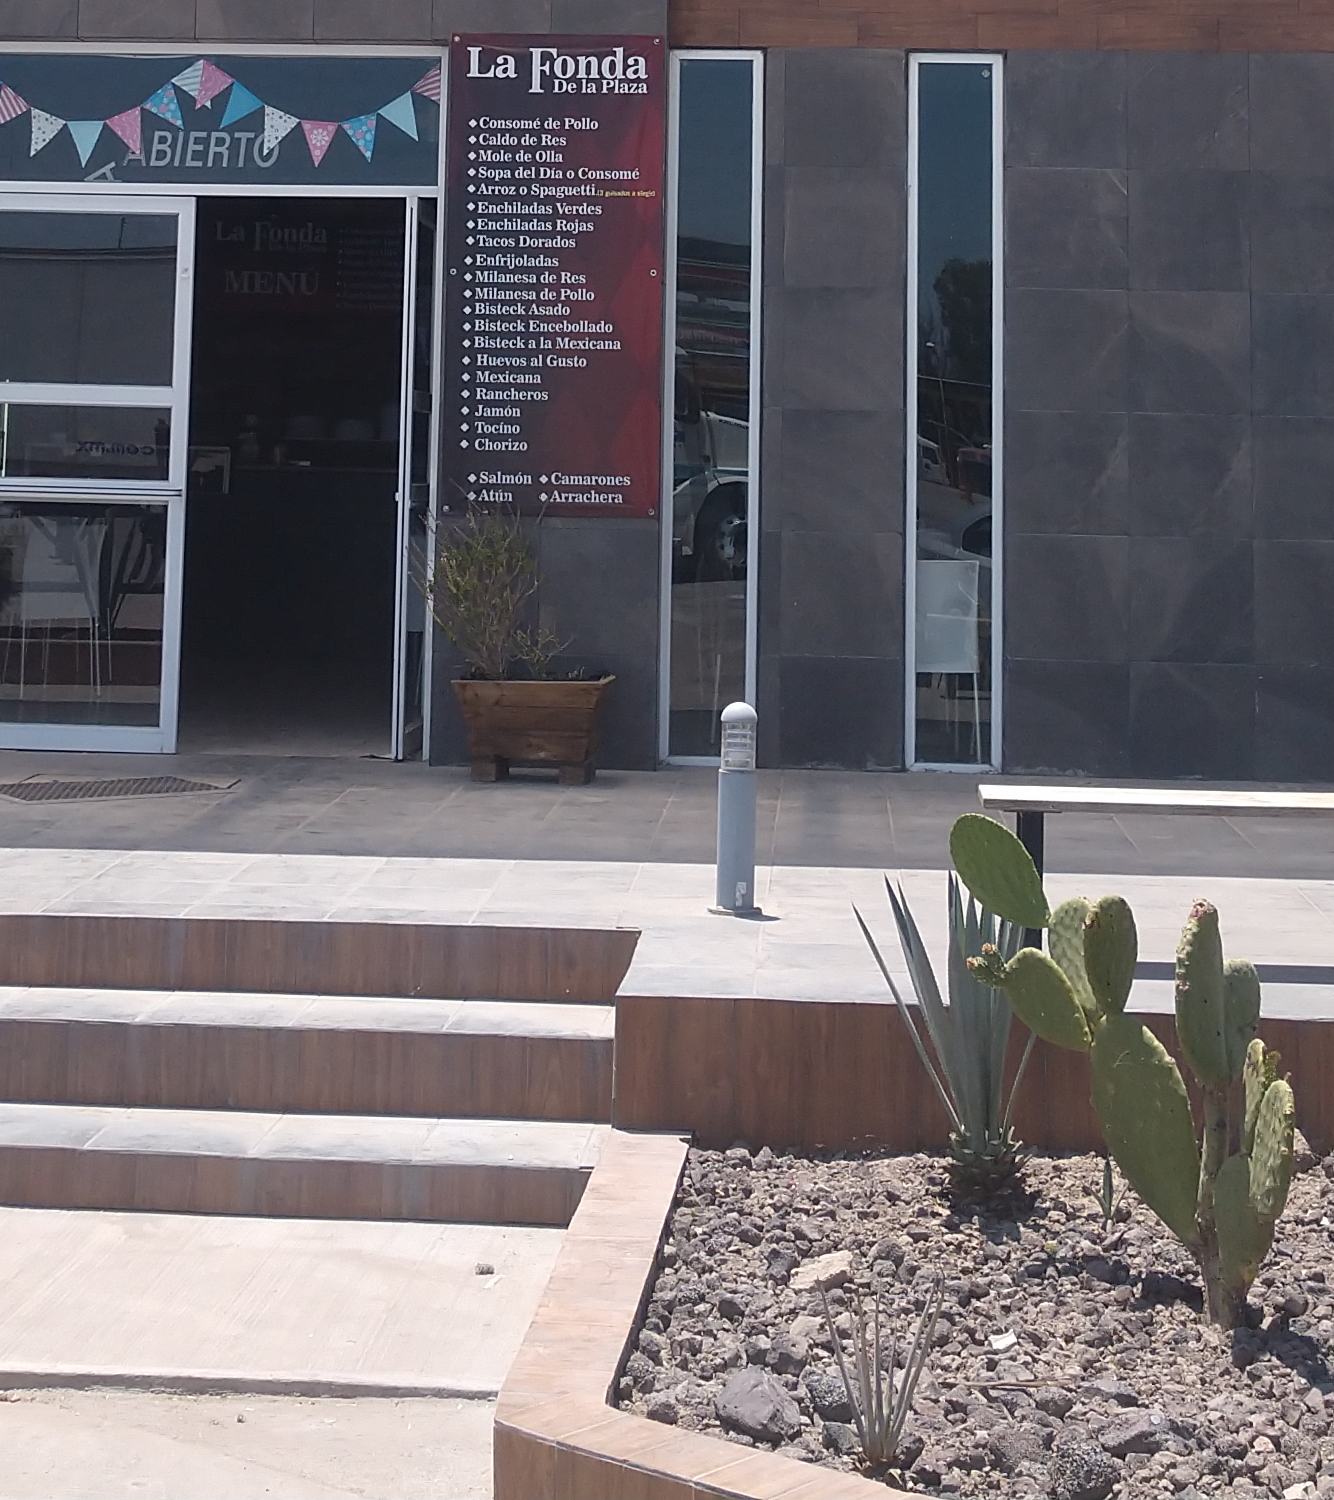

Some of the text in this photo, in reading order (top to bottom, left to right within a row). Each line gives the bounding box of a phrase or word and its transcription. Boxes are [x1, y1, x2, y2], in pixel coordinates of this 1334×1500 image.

[467, 47, 648, 93] La Fonda
[553, 79, 648, 94] De la Plaza
[479, 116, 599, 130] Consomé de Pollo
[479, 133, 566, 146] Caldo de Res
[478, 150, 563, 163] Mole de Olla
[478, 167, 640, 181] Sopa del Día o Consomé
[477, 184, 516, 195] Arroz
[519, 187, 527, 195] o
[478, 202, 602, 215] Enchiladas Verdes
[477, 219, 594, 234] Enchiladas Rojas
[477, 235, 576, 248] Tacos Dorados
[476, 254, 559, 269] Enfrijoladas
[475, 271, 586, 284] Milanesa de Res
[475, 288, 595, 301] Milanesa de Pollo
[475, 303, 570, 316] Bisteck Asado
[474, 320, 613, 333] Bisteck Encebollado
[474, 337, 621, 350] Bisteck a la Mexicana
[476, 354, 587, 367] Huevos al Gusto
[476, 371, 541, 384] Mexicana
[475, 388, 549, 400] Rancheros
[475, 405, 521, 417] Jamón
[474, 439, 528, 451] Chorizo
[479, 471, 631, 485] Salmón Camarones
[478, 491, 623, 503] Atún Arrachera
